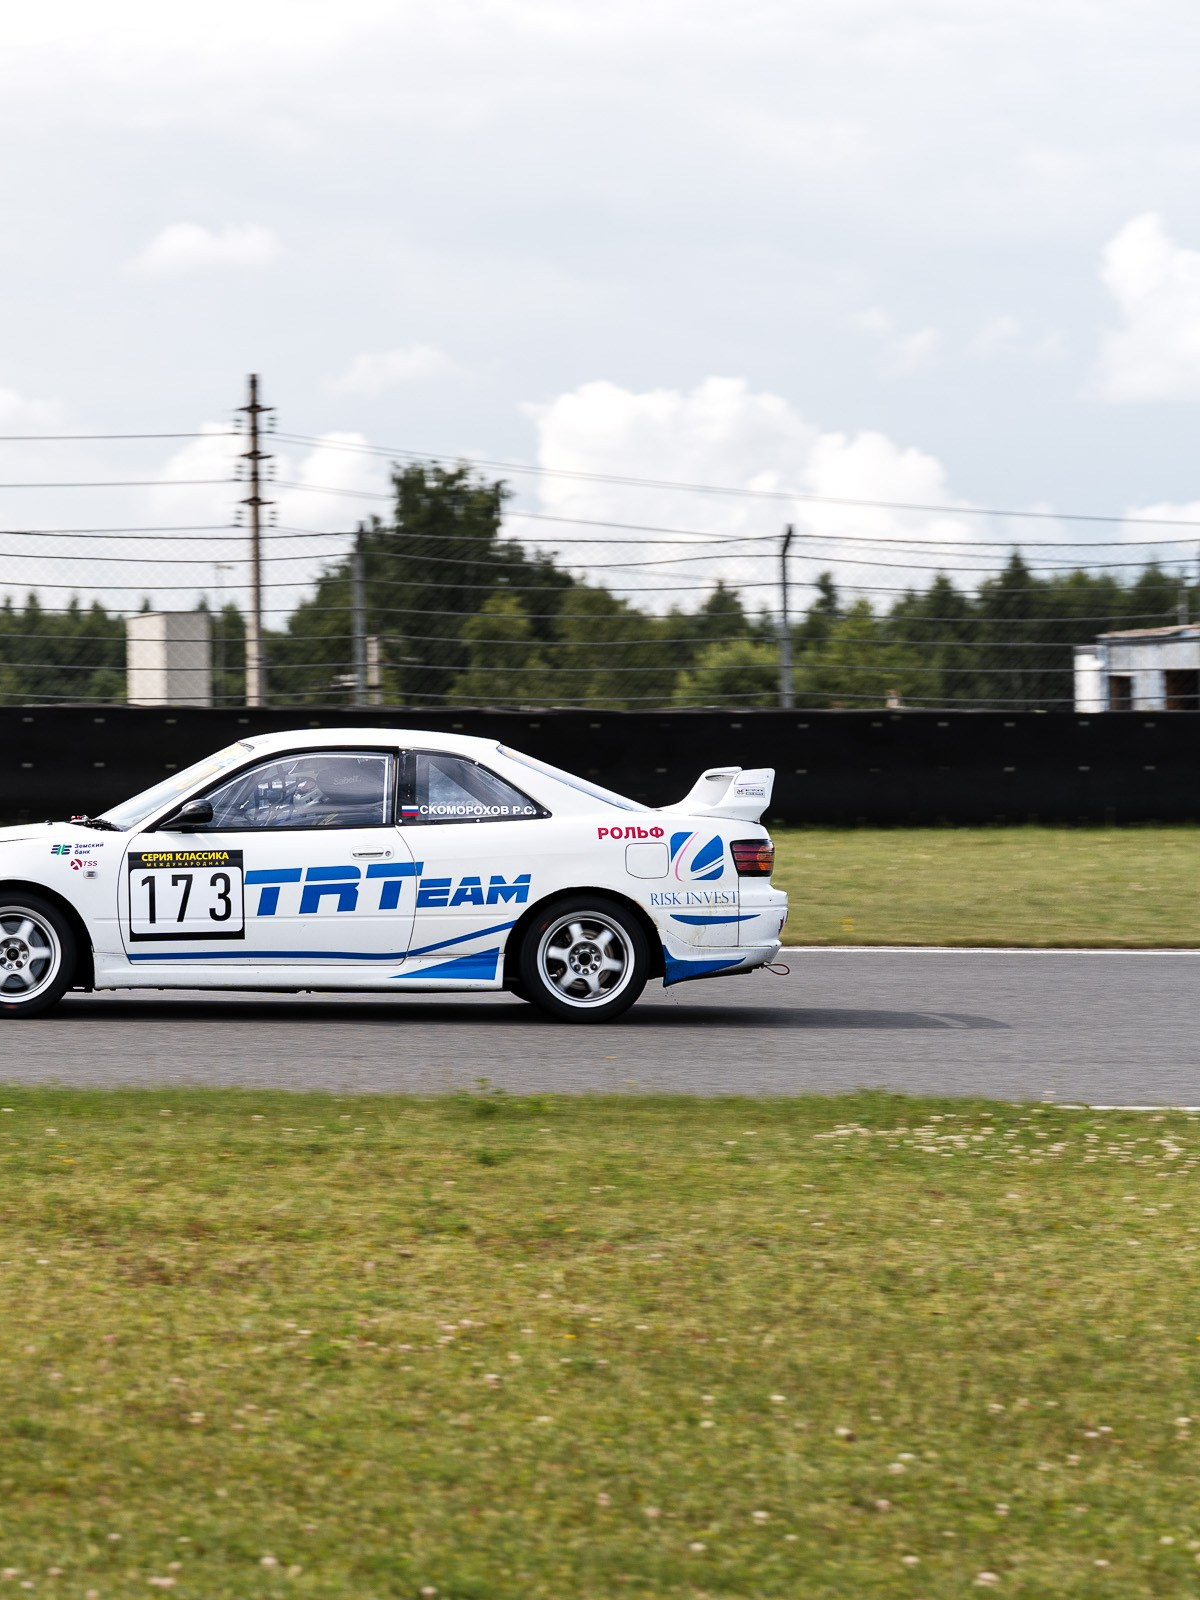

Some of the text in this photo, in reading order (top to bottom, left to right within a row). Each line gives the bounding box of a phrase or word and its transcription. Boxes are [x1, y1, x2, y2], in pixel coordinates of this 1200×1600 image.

[420, 805, 509, 815] СКОМОРОХОВ
[597, 826, 665, 840] РОЛЬФ
[141, 852, 229, 862] СЕРИЯ КЛАССИКА
[141, 872, 232, 924] 173
[650, 890, 739, 906] RISK INVEST
